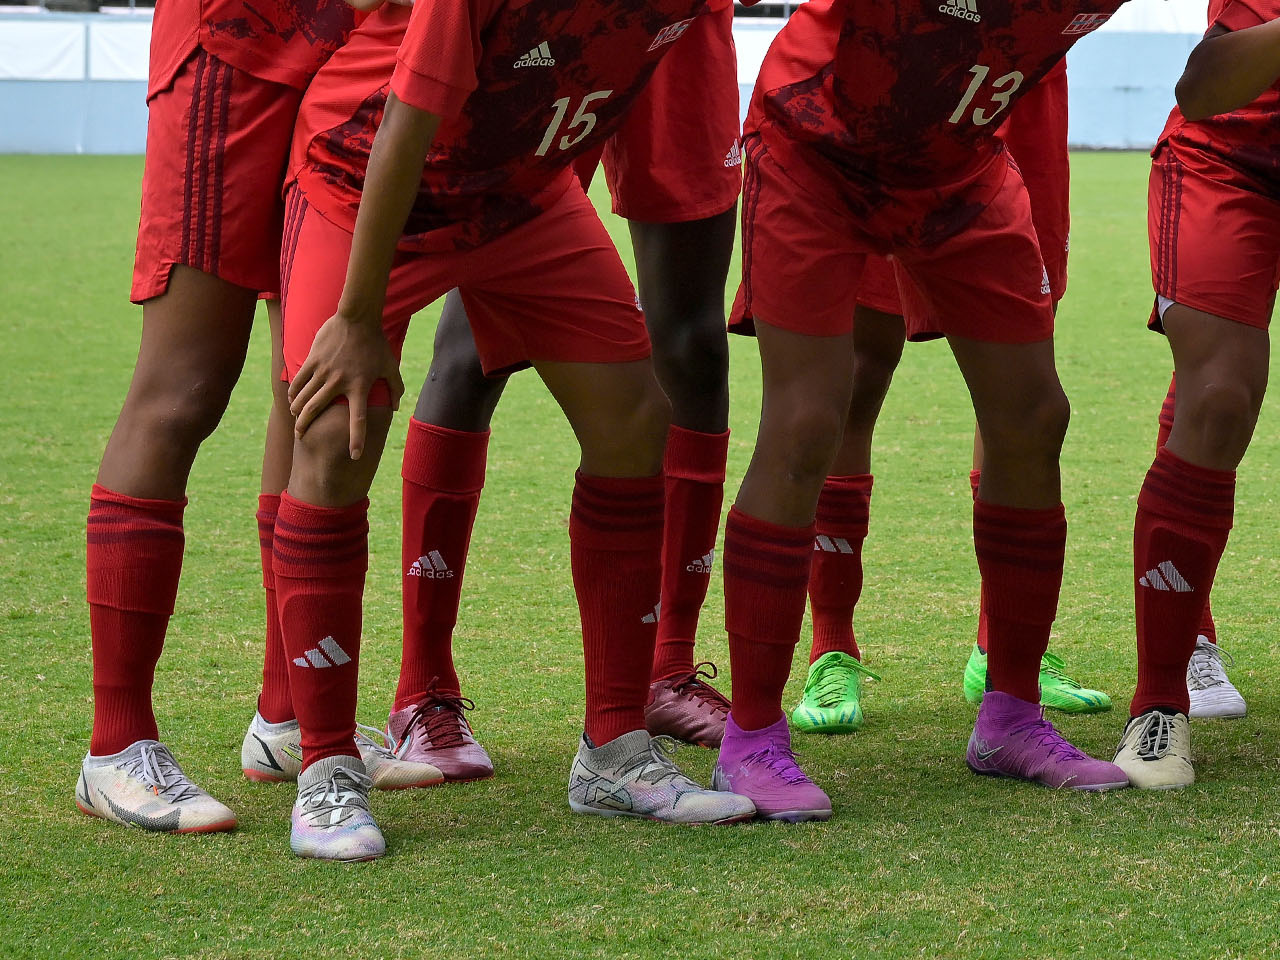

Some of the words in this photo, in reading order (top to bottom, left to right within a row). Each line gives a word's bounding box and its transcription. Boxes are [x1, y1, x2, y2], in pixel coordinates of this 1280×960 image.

[938, 2, 981, 24] adidas
[513, 57, 556, 69] adidas
[948, 64, 1024, 126] 13
[534, 89, 613, 157] 15
[407, 567, 454, 579] adidas
